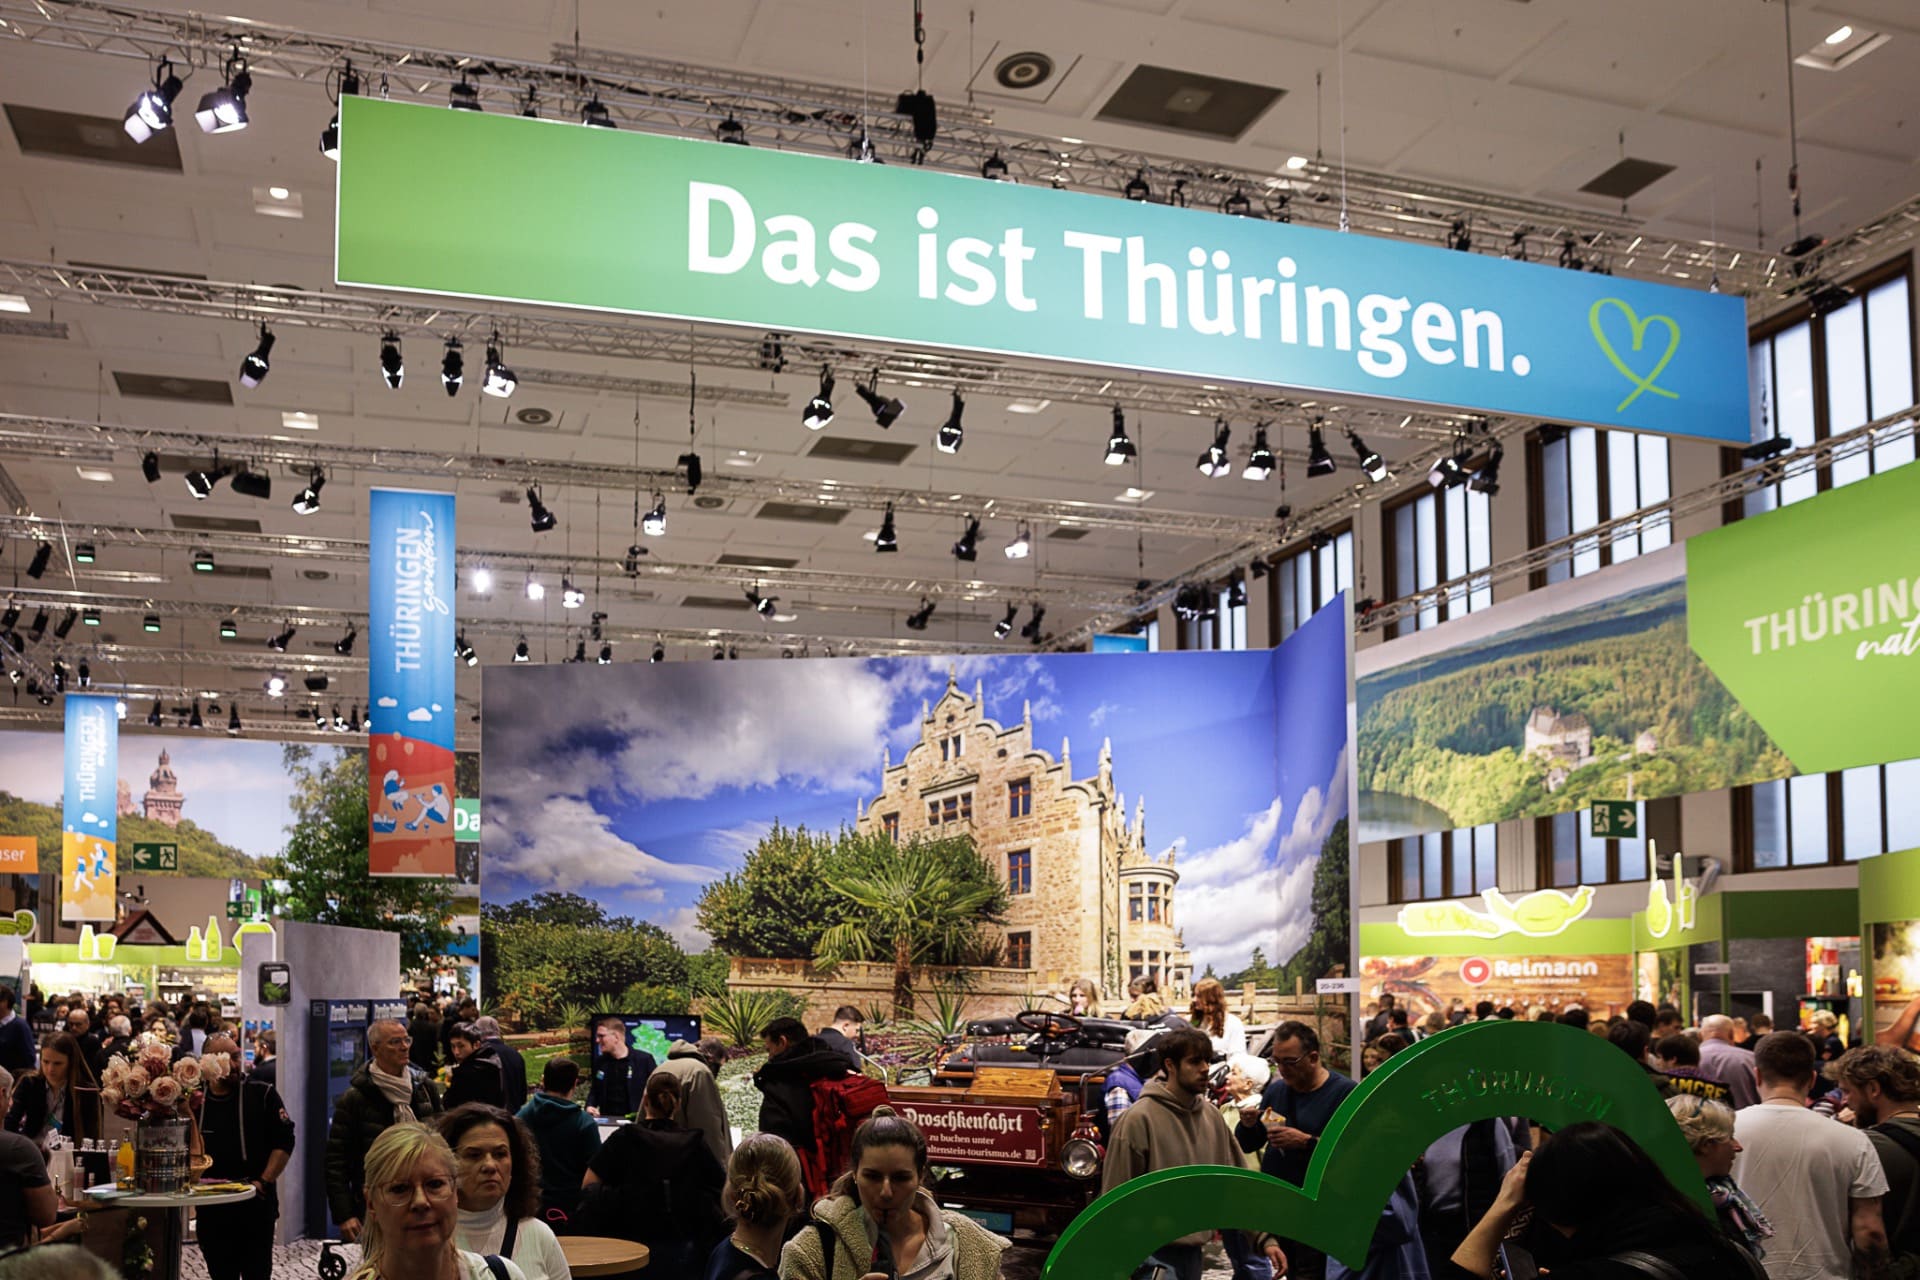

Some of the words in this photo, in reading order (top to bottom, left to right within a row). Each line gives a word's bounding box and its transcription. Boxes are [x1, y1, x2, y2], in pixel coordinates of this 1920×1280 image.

[688, 181, 880, 292] Das
[917, 206, 1038, 312] ist
[1063, 230, 1531, 378] Thüringen.
[390, 528, 422, 673] THÜRINGEN
[76, 715, 97, 803] THÜRINGEN
[1494, 957, 1598, 977] Reimann
[1420, 1068, 1614, 1120] THÜRINGEN
[902, 1107, 1023, 1134] Droschkenfahrt
[929, 1134, 939, 1142] zu
[940, 1133, 970, 1144] buchen
[972, 1136, 995, 1145] unter
